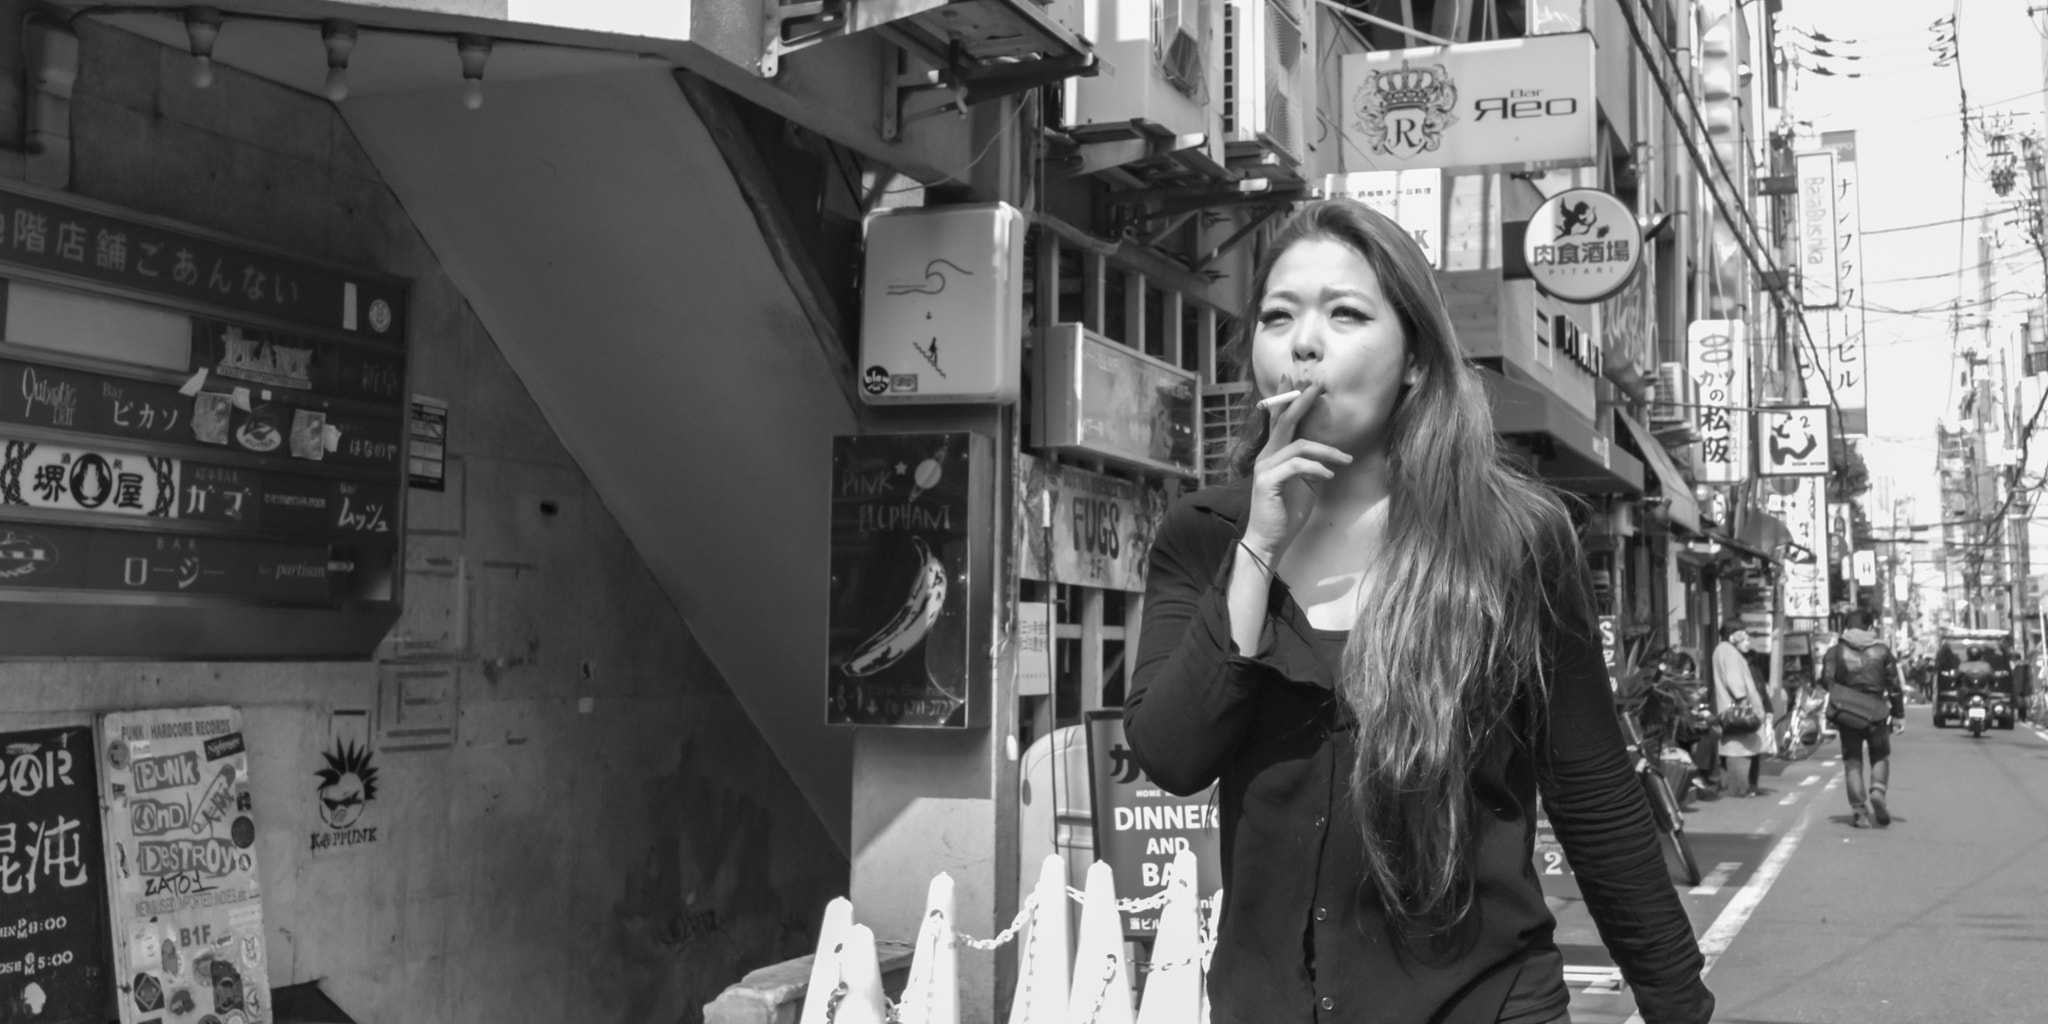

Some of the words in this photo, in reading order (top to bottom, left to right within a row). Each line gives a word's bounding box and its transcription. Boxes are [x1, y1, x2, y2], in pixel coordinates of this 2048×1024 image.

[1510, 88, 1543, 99] Bar
[1390, 118, 1422, 148] R
[1533, 240, 1630, 266] 肉食酒場
[1548, 267, 1613, 275] PITARI
[1699, 333, 1736, 463] 串カツの松阪
[113, 472, 144, 509] 屋
[842, 469, 894, 497] PINK
[1073, 496, 1119, 560] FUGS
[157, 537, 196, 551] BAR
[124, 557, 226, 589] ロージー
[275, 561, 326, 580] partisan
[121, 725, 144, 741] PUNK
[151, 721, 194, 739] HARDCORE
[195, 719, 231, 736] RECORDS
[1135, 789, 1162, 798] HOME
[1114, 805, 1220, 831] DINNER
[1146, 837, 1190, 855] AND
[180, 924, 211, 947] B1F
[38, 950, 74, 970] 5:00
